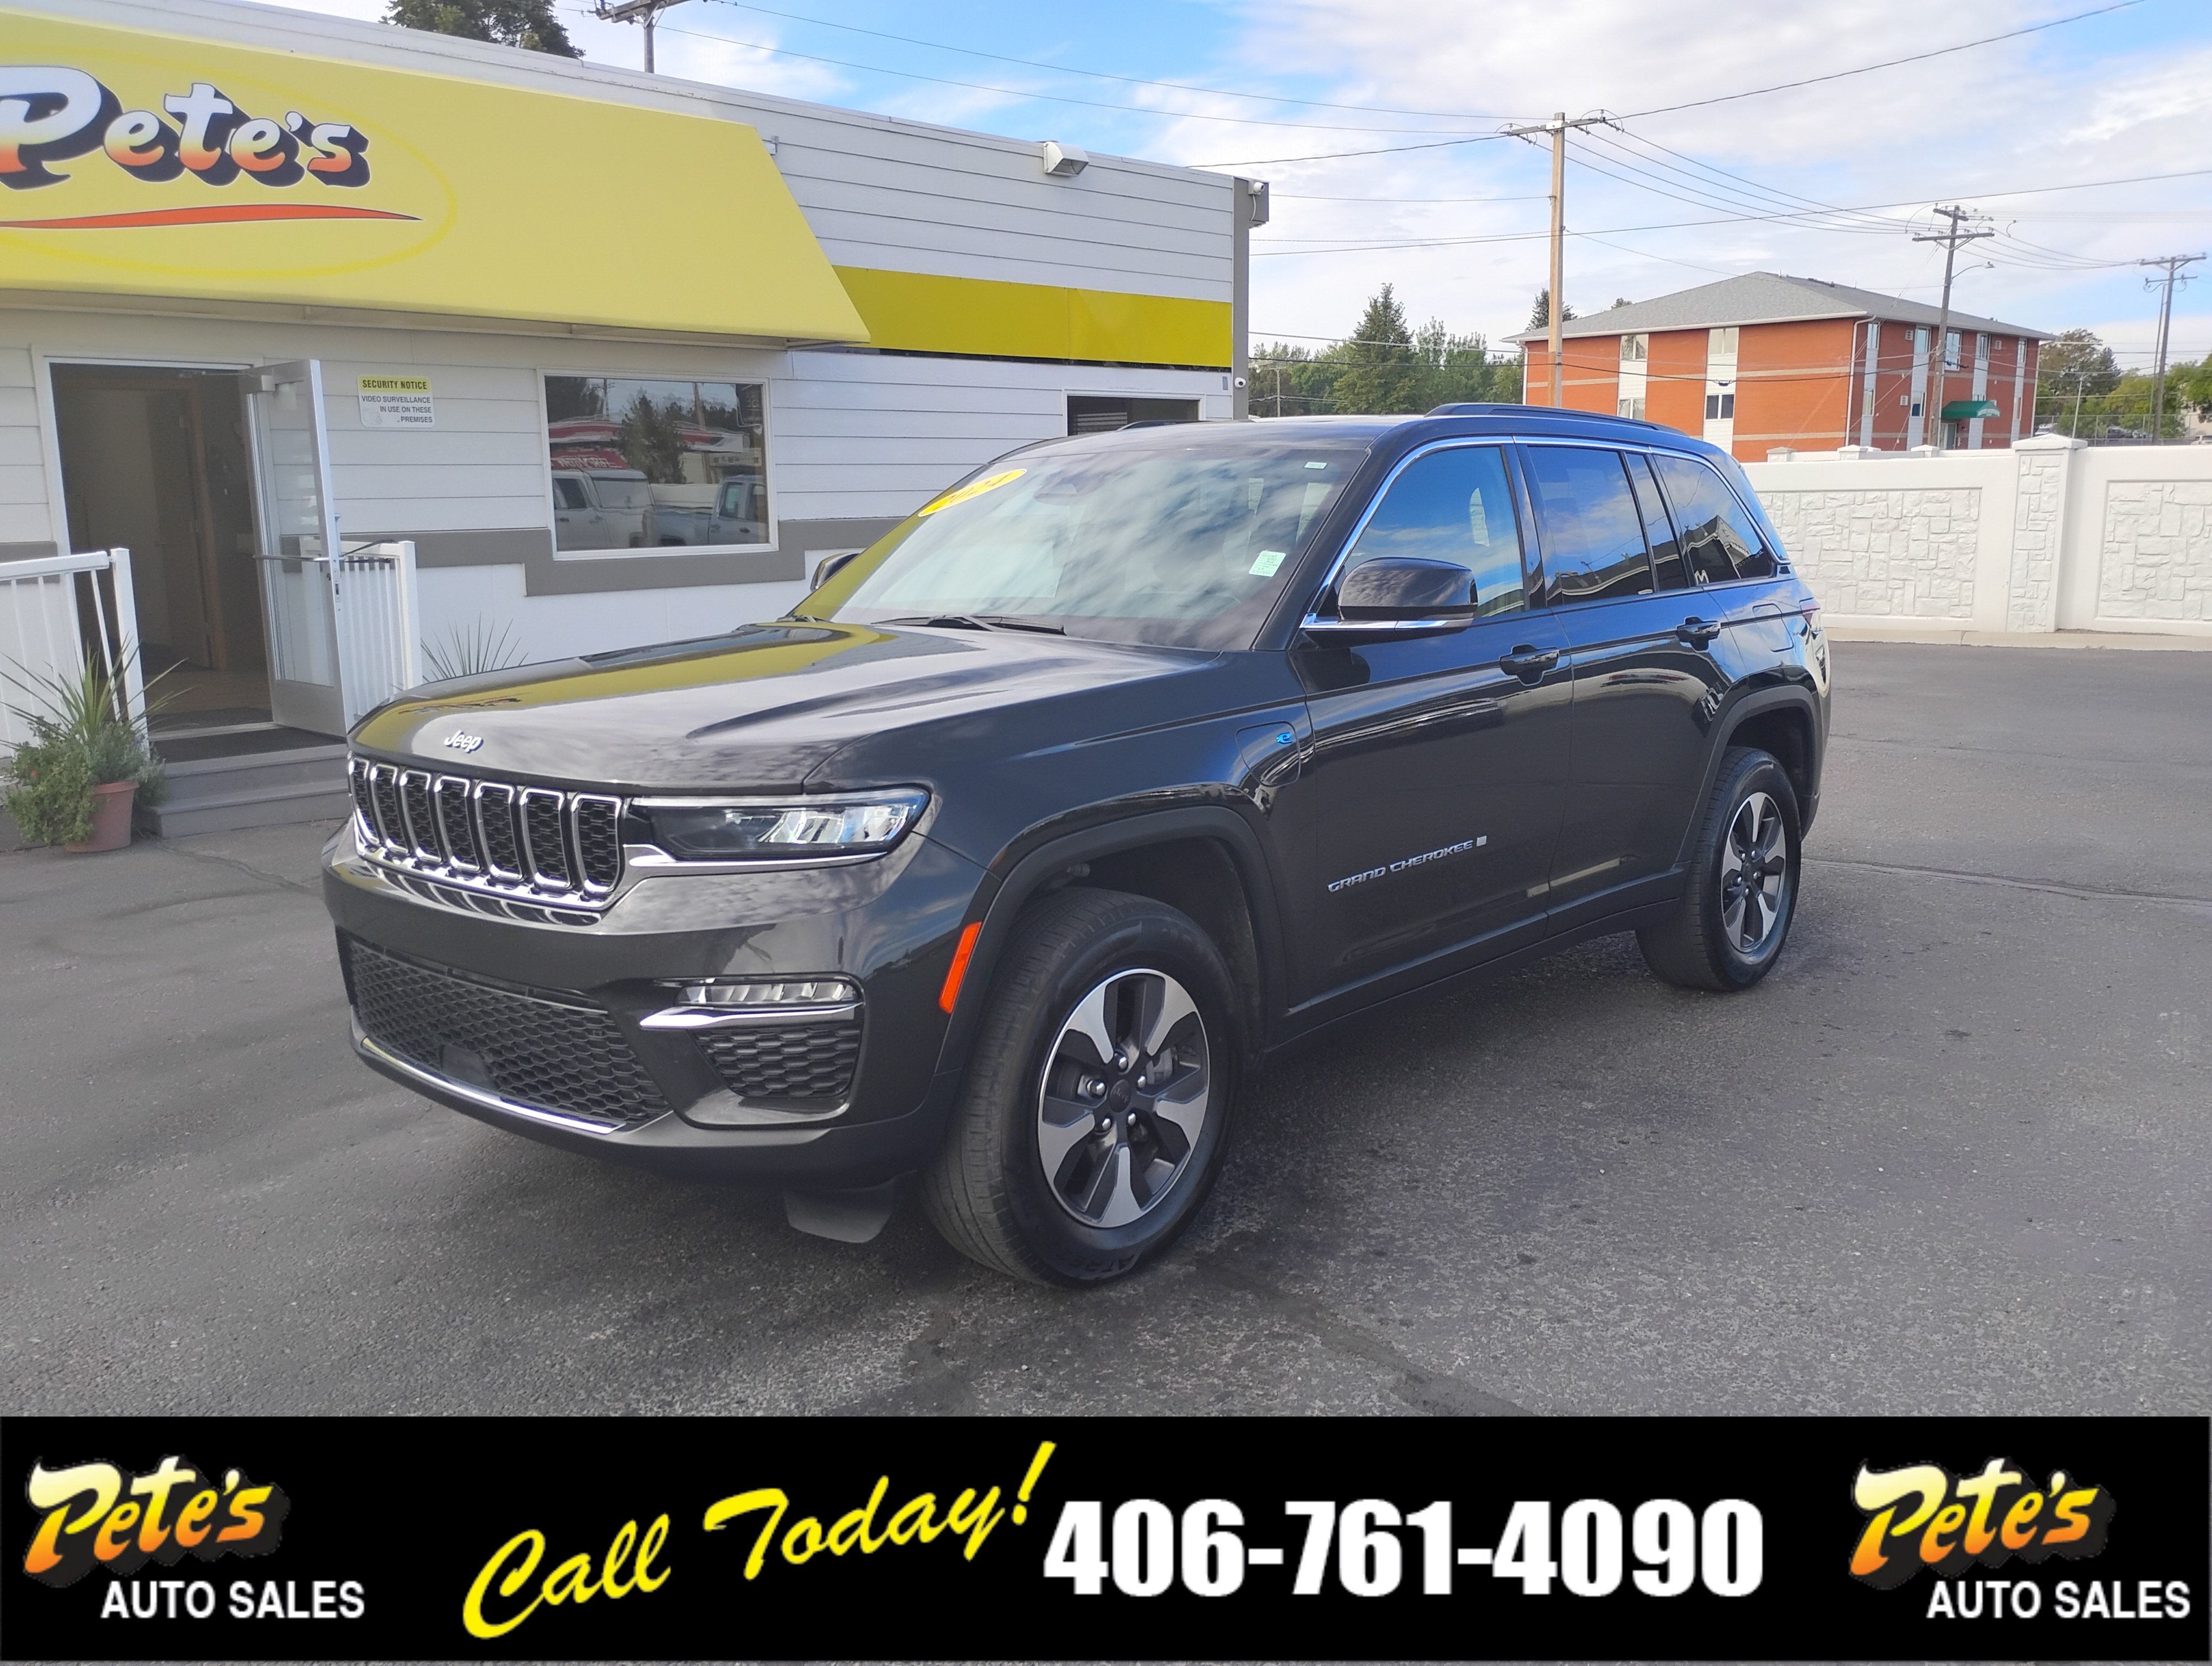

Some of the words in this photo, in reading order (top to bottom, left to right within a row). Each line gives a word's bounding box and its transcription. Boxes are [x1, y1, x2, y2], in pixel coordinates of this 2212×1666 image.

[363, 380, 398, 389] SECURITY
[401, 381, 427, 389] NOTICE
[444, 730, 483, 753] Jeep
[1328, 867, 1386, 893] GRAND
[1390, 840, 1474, 873] CHEROKEE
